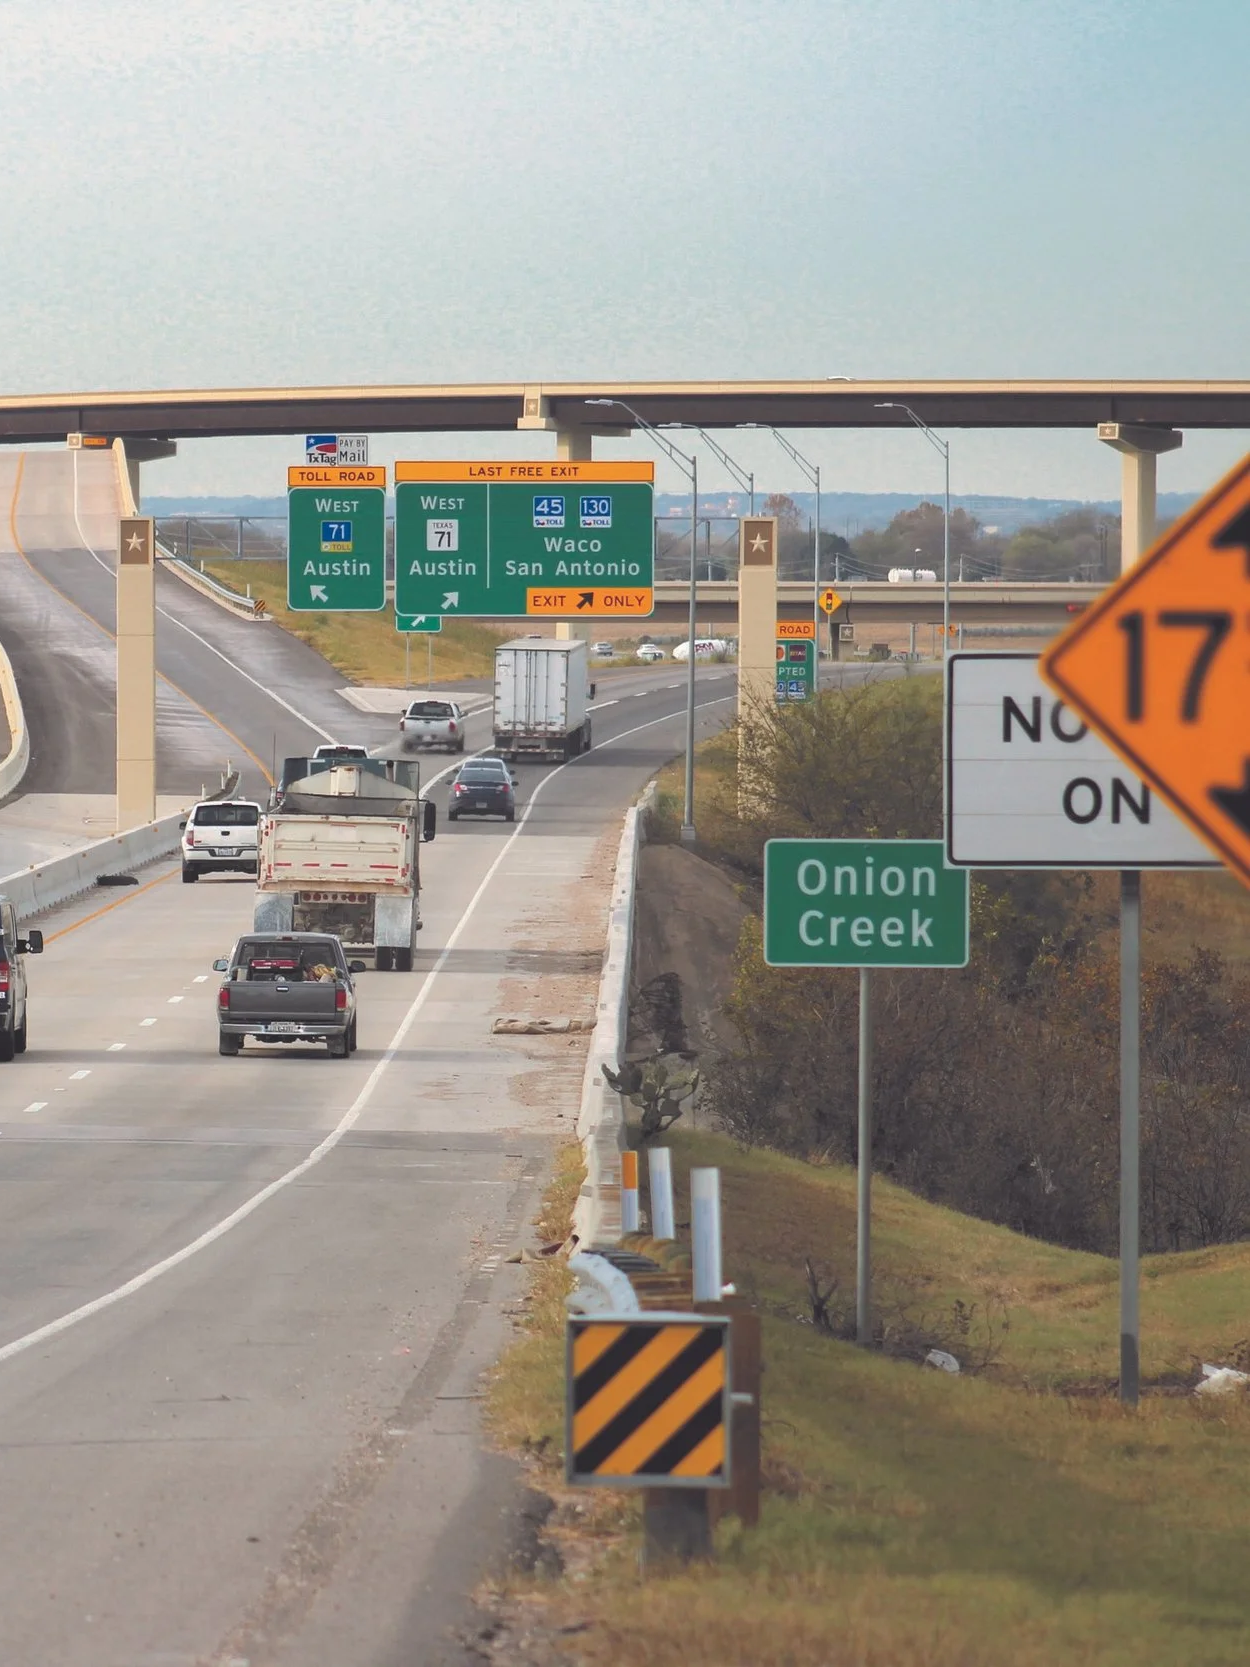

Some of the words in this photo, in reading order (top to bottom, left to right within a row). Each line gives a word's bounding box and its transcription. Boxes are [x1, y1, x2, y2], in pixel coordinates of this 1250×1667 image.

[340, 439, 354, 448] PAY
[356, 439, 366, 448] BY
[306, 452, 336, 466] TxTag
[339, 450, 366, 462] Mail
[299, 472, 332, 482] TOLL
[340, 472, 375, 482] ROAD
[469, 467, 502, 477] LAST
[510, 467, 543, 477] FREE
[551, 467, 579, 476] EXIT
[315, 498, 359, 513] WEST
[420, 496, 465, 510] WEST
[536, 500, 562, 514] 45
[582, 500, 610, 514] 130
[328, 524, 346, 540] 71
[434, 531, 452, 548] 71
[544, 537, 602, 552] Waco
[304, 559, 370, 576] Austin
[409, 559, 476, 576] Austin
[505, 560, 543, 576] San
[556, 559, 640, 576] Antonio
[534, 596, 566, 606] EXIT
[604, 596, 644, 606] ONLY
[780, 626, 810, 634] ROAD
[1062, 777, 1151, 824] ON
[797, 858, 936, 897] Onion
[799, 909, 934, 947] Creek
